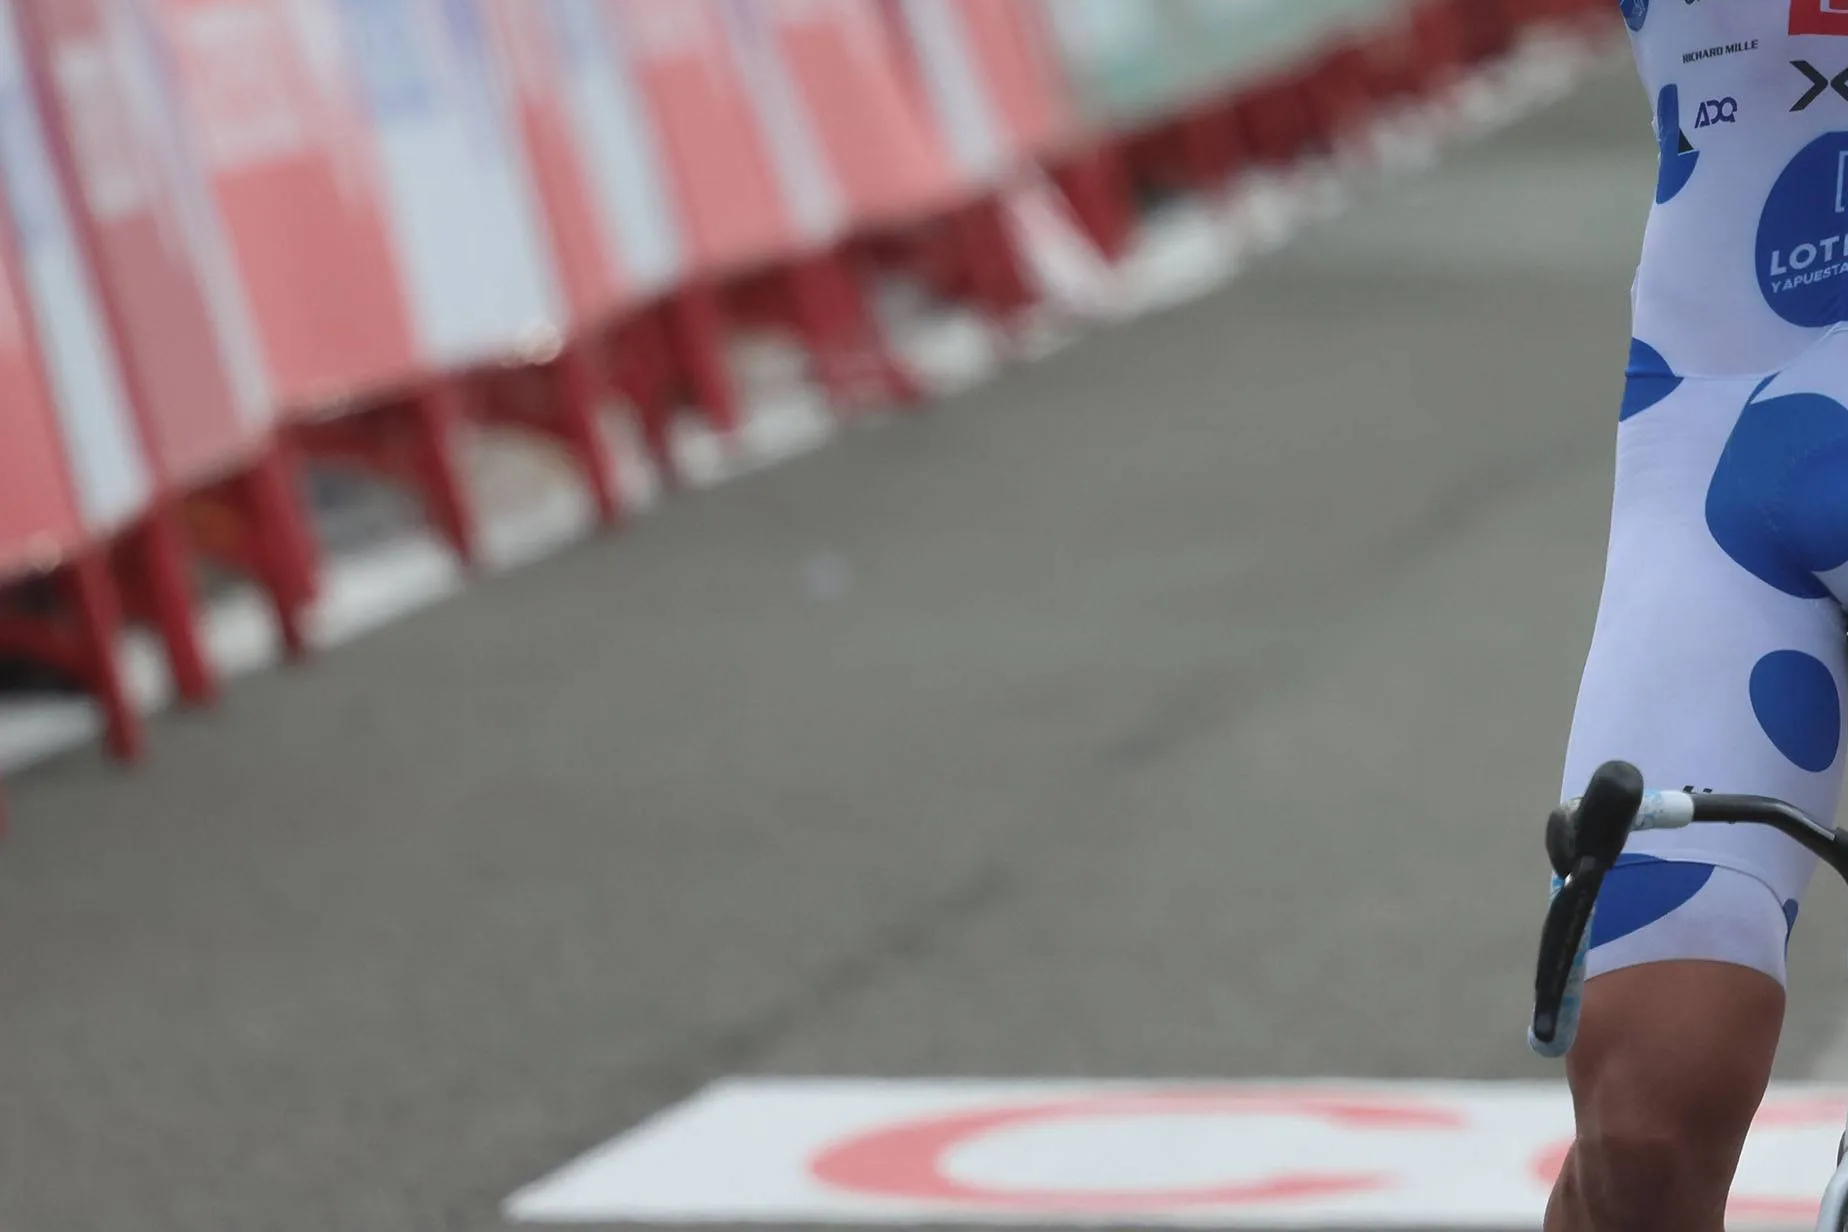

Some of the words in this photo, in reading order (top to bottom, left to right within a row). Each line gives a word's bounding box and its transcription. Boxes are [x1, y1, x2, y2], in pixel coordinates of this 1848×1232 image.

[1682, 45, 1724, 64] RICHARD
[1724, 39, 1759, 55] MILLE
[1770, 281, 1782, 294] Y
